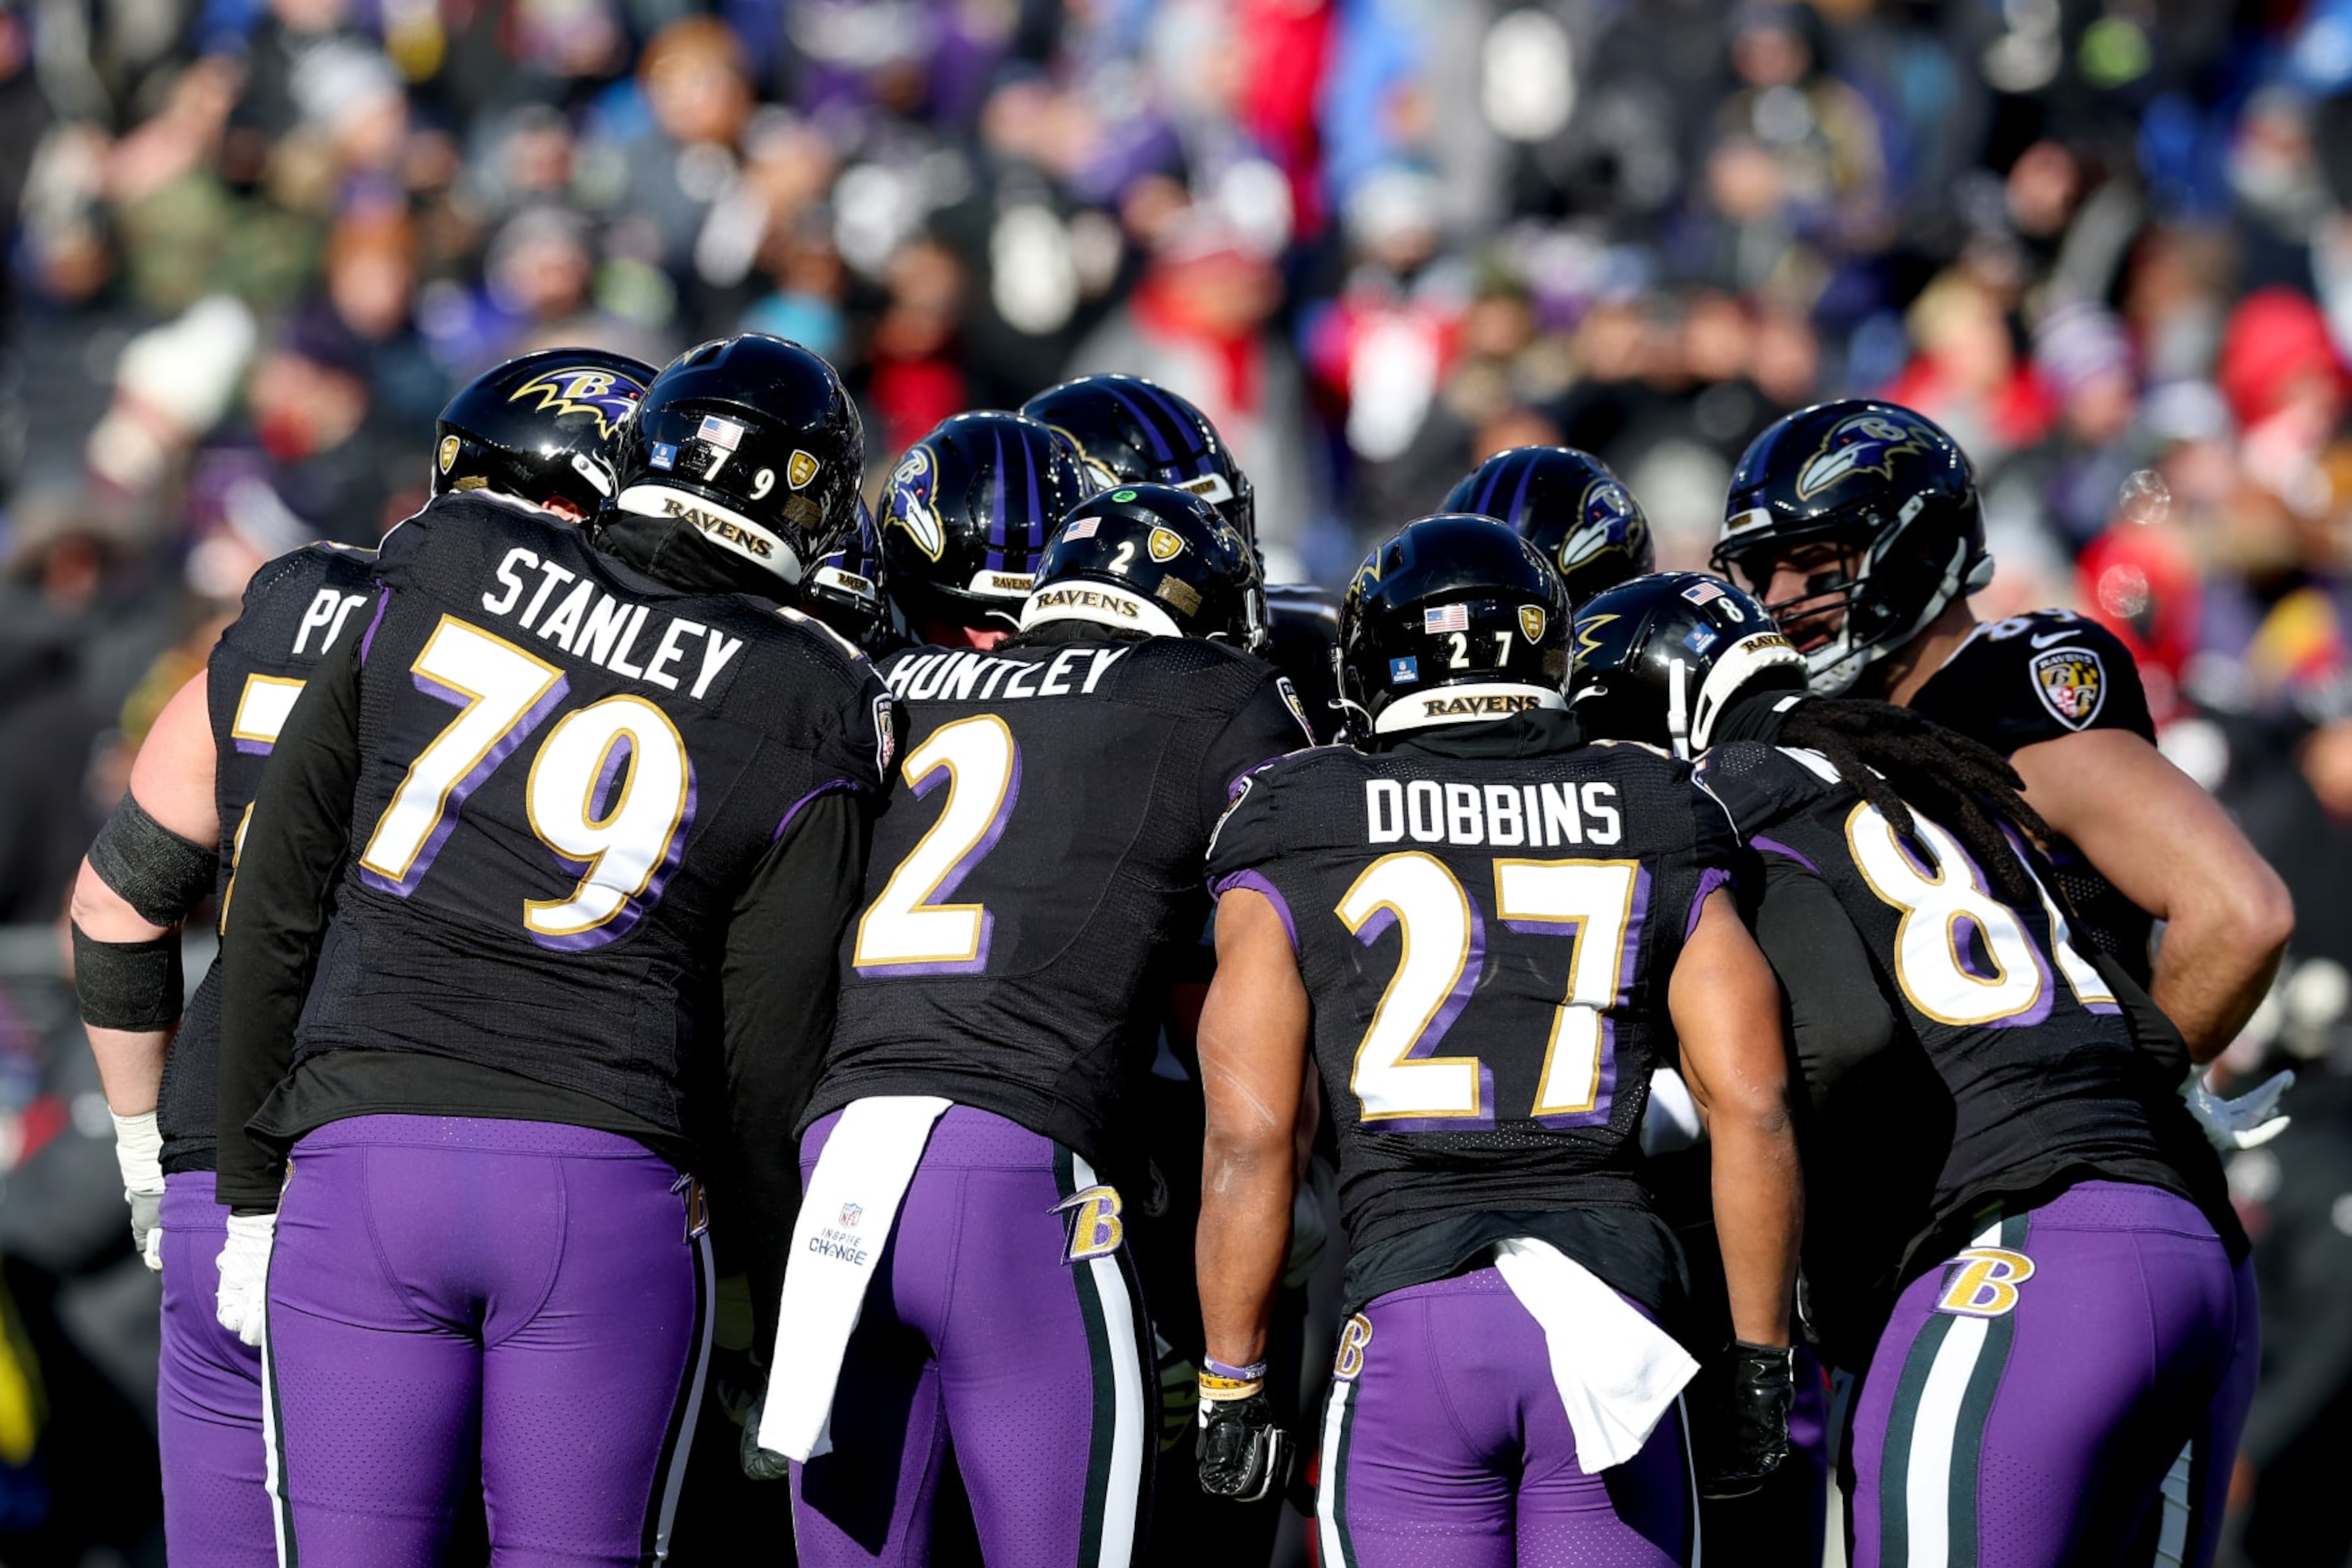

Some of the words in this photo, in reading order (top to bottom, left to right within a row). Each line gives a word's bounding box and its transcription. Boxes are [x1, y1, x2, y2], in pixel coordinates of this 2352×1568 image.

[562, 369, 616, 398] B
[662, 497, 775, 560] RAVENS
[1107, 541, 1135, 574] 2
[992, 575, 1033, 590] RAVENS
[1035, 589, 1141, 619] RAVENS
[481, 546, 743, 701] STANLEY
[886, 646, 1129, 701] HUNTLEY
[2039, 654, 2093, 669] RAVENS
[1422, 695, 1542, 718] RAVENS
[358, 614, 697, 950] 79
[1365, 778, 1622, 847] DOBBINS
[853, 714, 1021, 978] 2
[1334, 850, 1651, 1132] 27
[809, 1237, 868, 1266] CHANGE
[821, 1227, 862, 1248] INSPIRE
[1046, 1185, 1124, 1262] B
[1934, 1247, 2035, 1317] B
[1333, 1312, 1373, 1381] B
